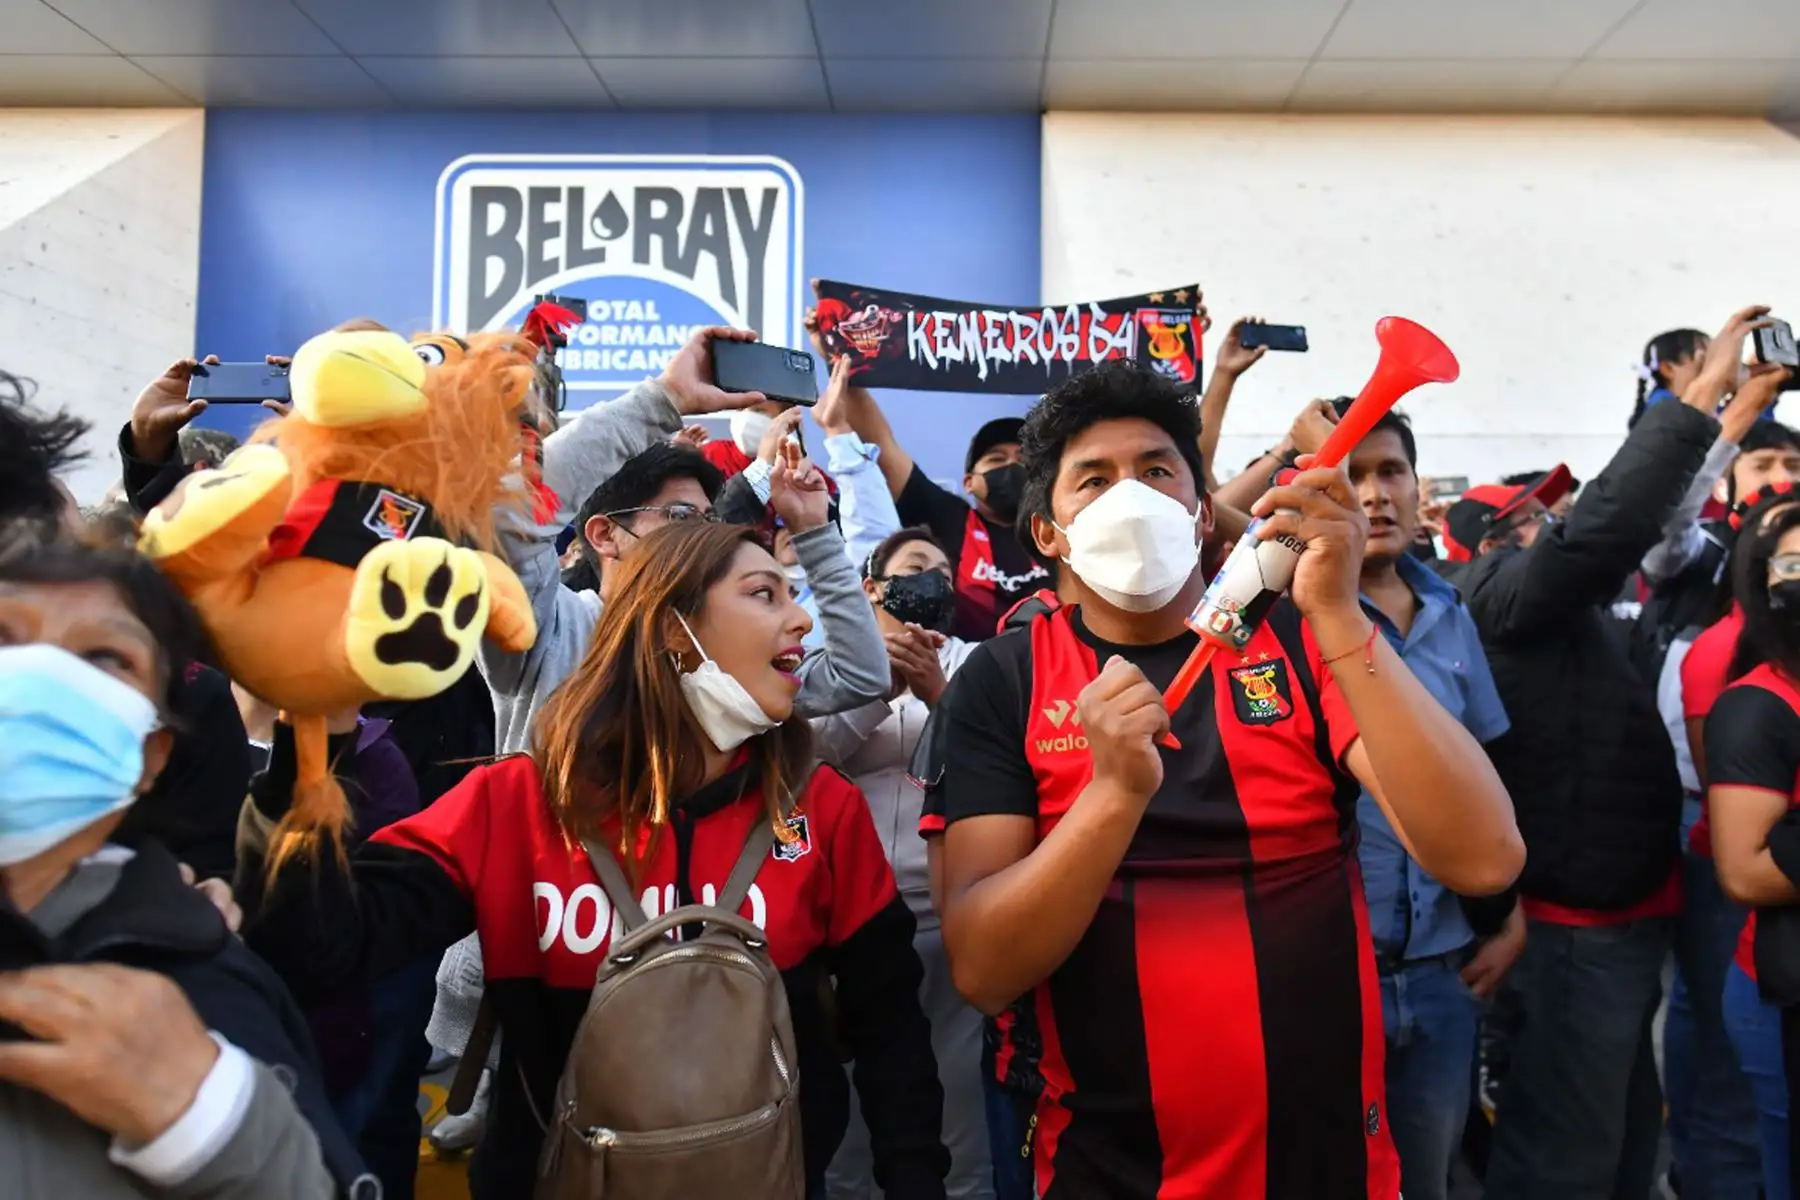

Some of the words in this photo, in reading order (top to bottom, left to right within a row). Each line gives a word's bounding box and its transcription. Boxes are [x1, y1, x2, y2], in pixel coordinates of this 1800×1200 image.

[587, 300, 661, 322] OTAL
[907, 303, 1080, 381] KEMEROS
[1036, 733, 1089, 754] walo
